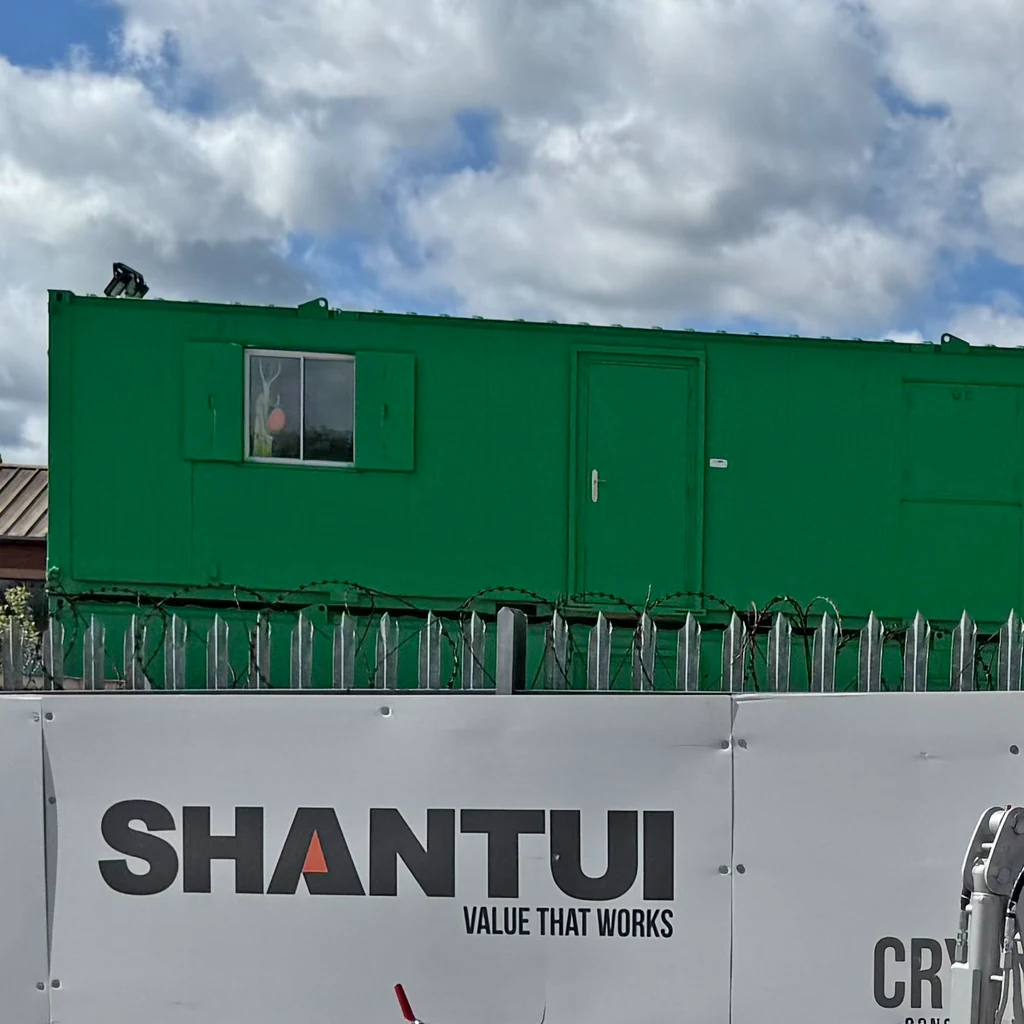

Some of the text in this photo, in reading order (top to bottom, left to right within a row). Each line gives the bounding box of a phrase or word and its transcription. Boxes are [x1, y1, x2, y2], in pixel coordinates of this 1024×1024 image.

[99, 799, 675, 901] SHANTUI
[463, 906, 674, 938] VALUE THAT WORKS
